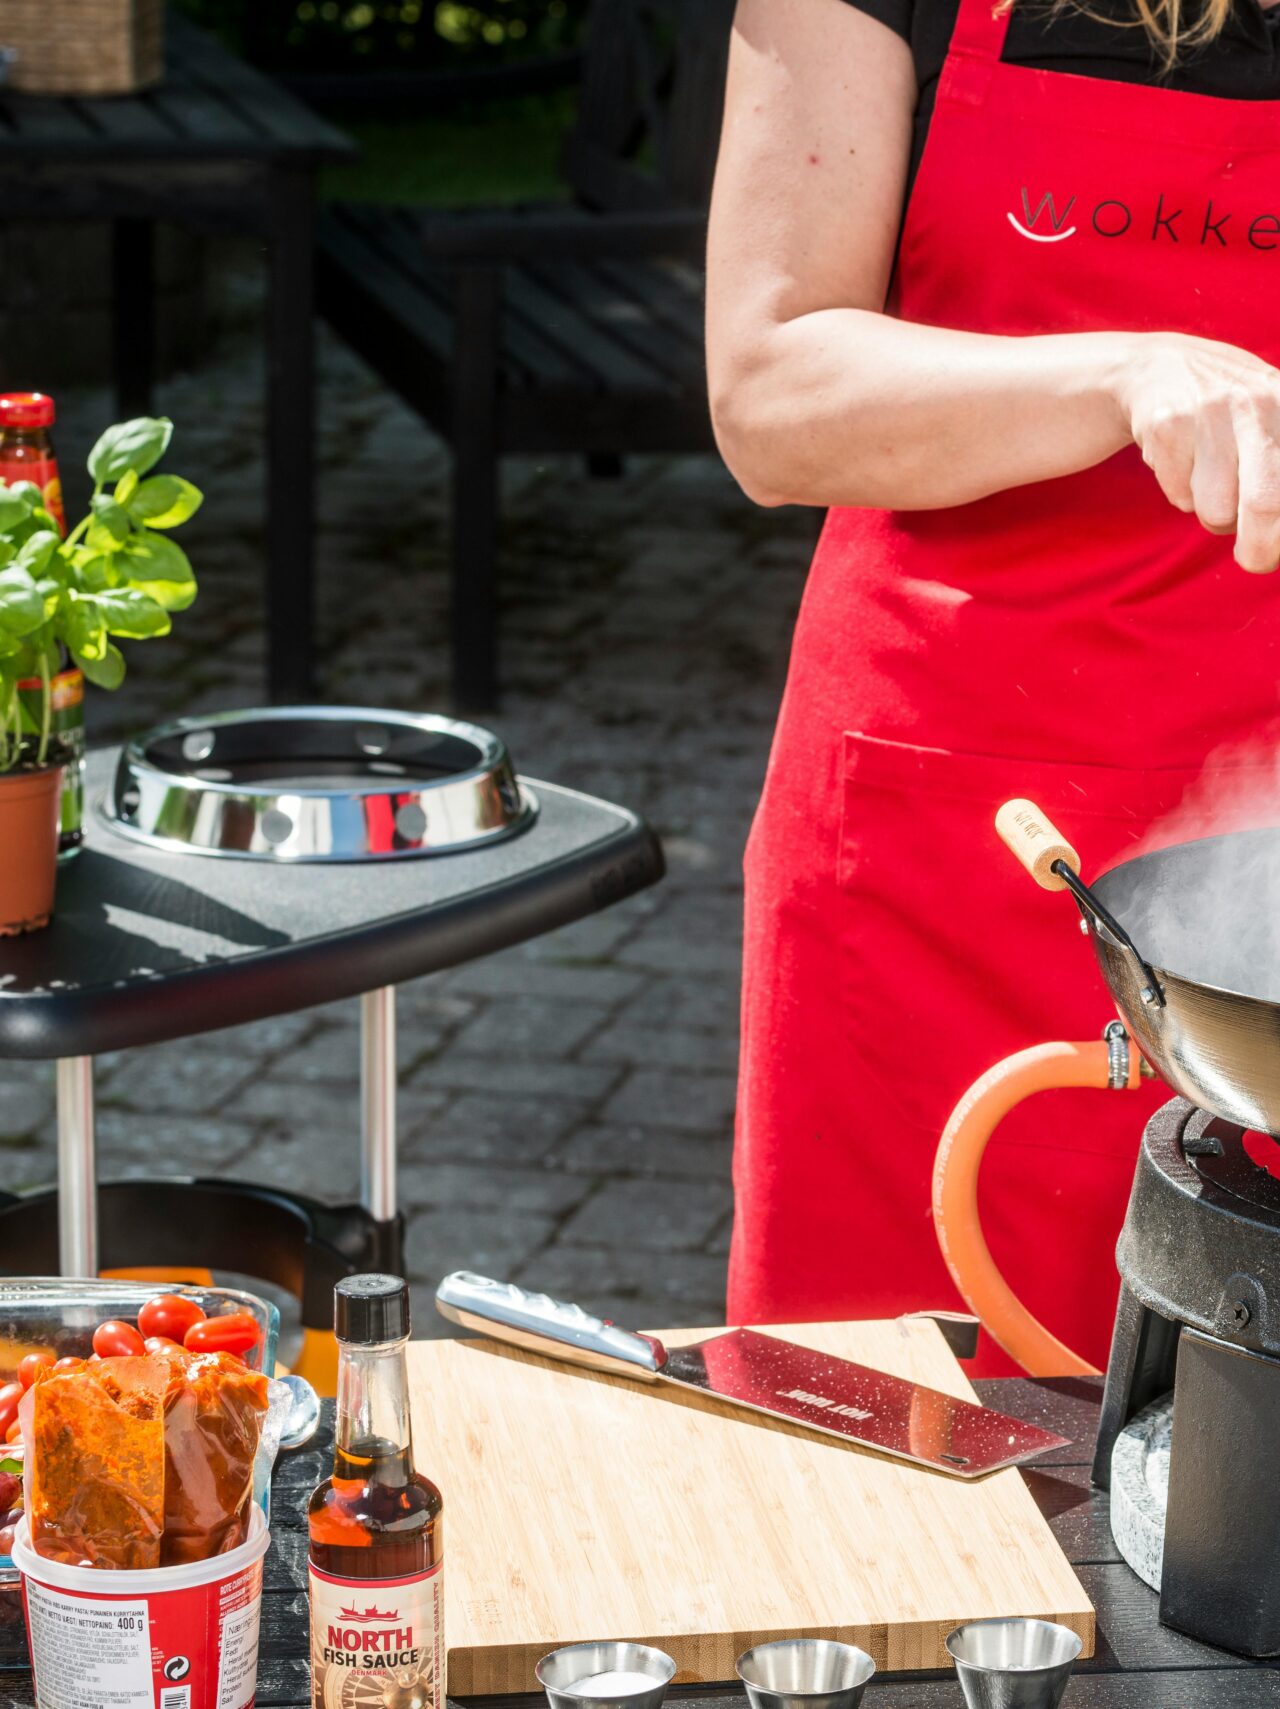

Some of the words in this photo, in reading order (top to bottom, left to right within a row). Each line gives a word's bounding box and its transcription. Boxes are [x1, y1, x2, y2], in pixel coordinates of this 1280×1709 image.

[827, 1404, 875, 1421] HOT
[48, 1609, 62, 1622] NETTO
[117, 1617, 135, 1630] 400
[137, 1619, 143, 1631] g
[328, 1625, 413, 1652] NORTH
[324, 1647, 357, 1667] FISH
[363, 1648, 418, 1669] SAUCE
